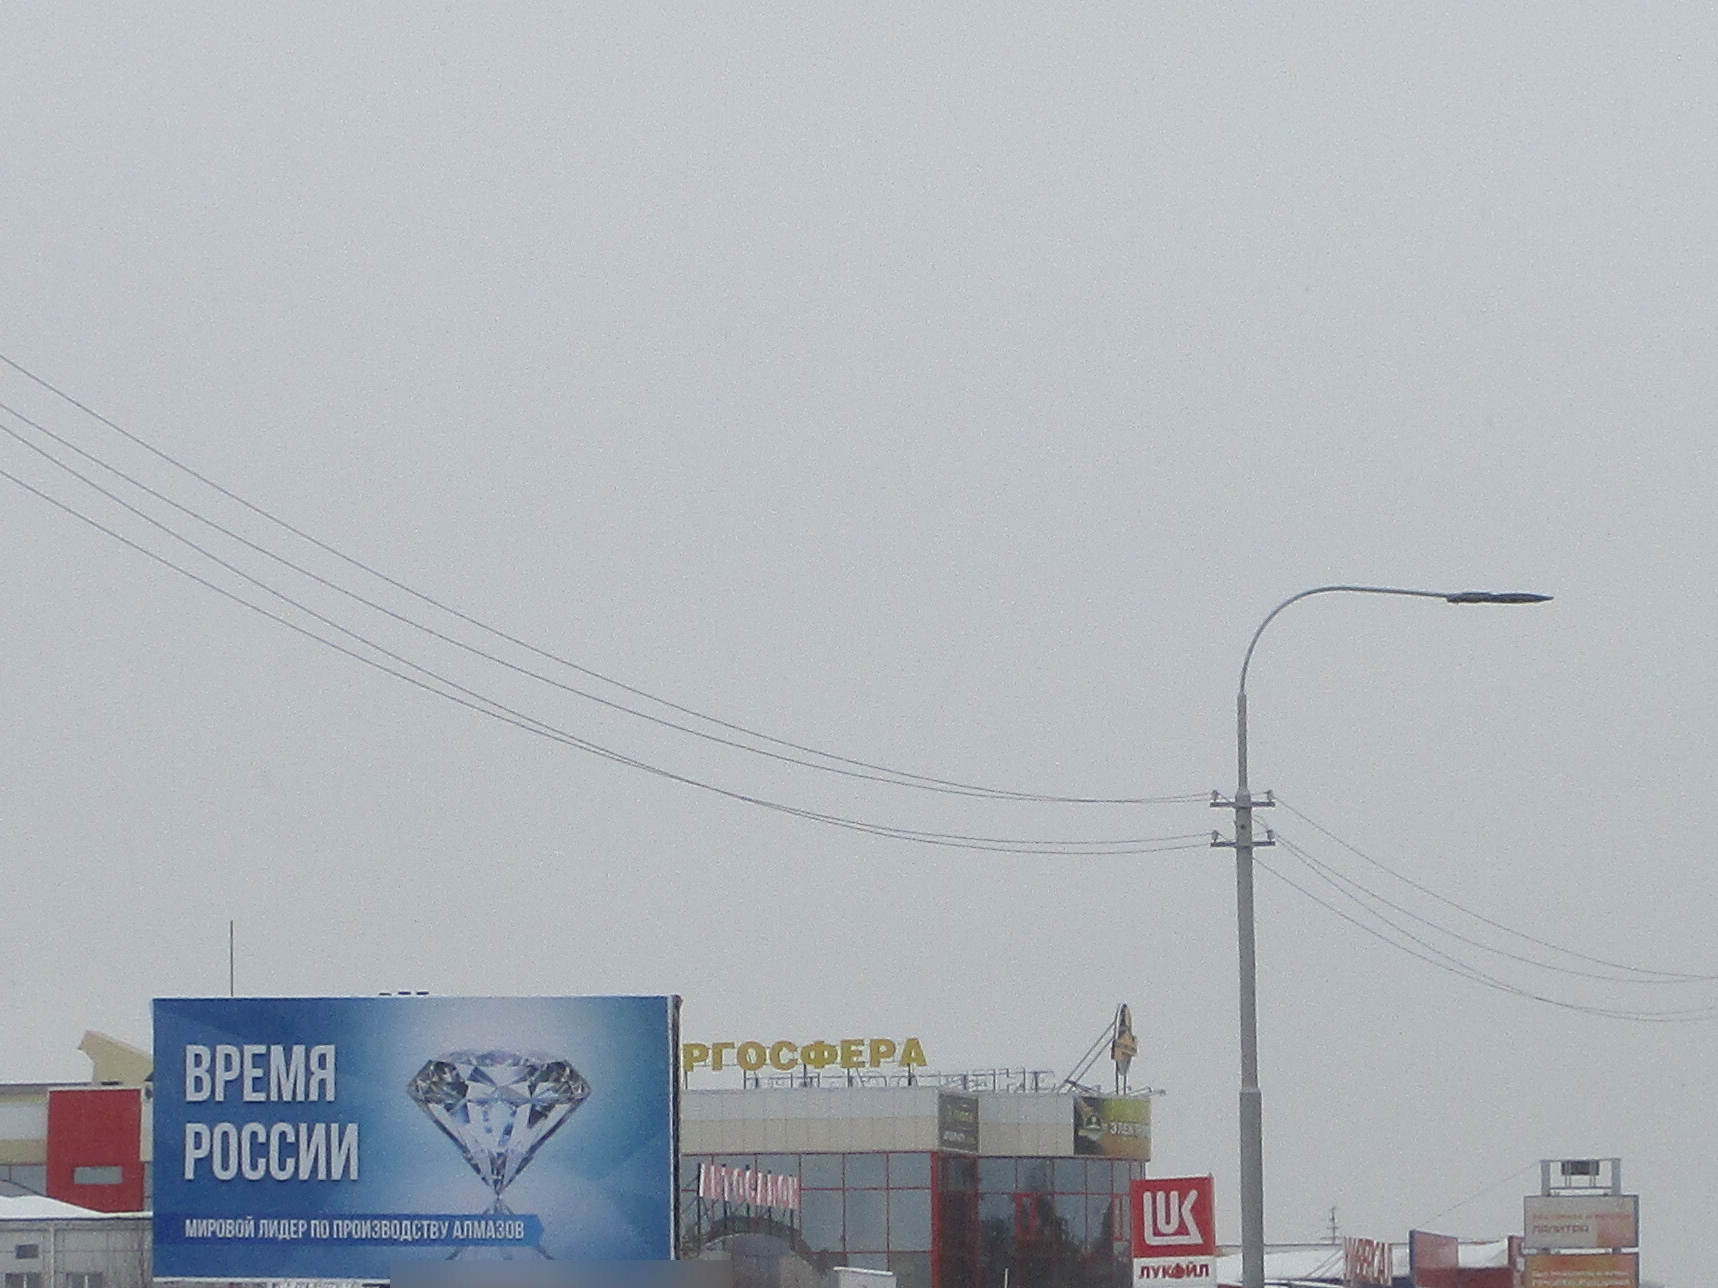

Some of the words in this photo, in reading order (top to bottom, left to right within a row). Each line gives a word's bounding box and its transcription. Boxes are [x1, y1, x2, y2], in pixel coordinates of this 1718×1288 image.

[185, 1044, 336, 1103] ВРЕМЯ
[184, 1121, 360, 1181] РОССИИ
[185, 1216, 255, 1239] МИРОВОЙ
[258, 1219, 308, 1240] ЛИДЕР
[311, 1220, 330, 1238] ПО
[333, 1219, 449, 1241] ПРОИЗВОДСТВУ
[452, 1220, 525, 1239] АЛМАЗОВ
